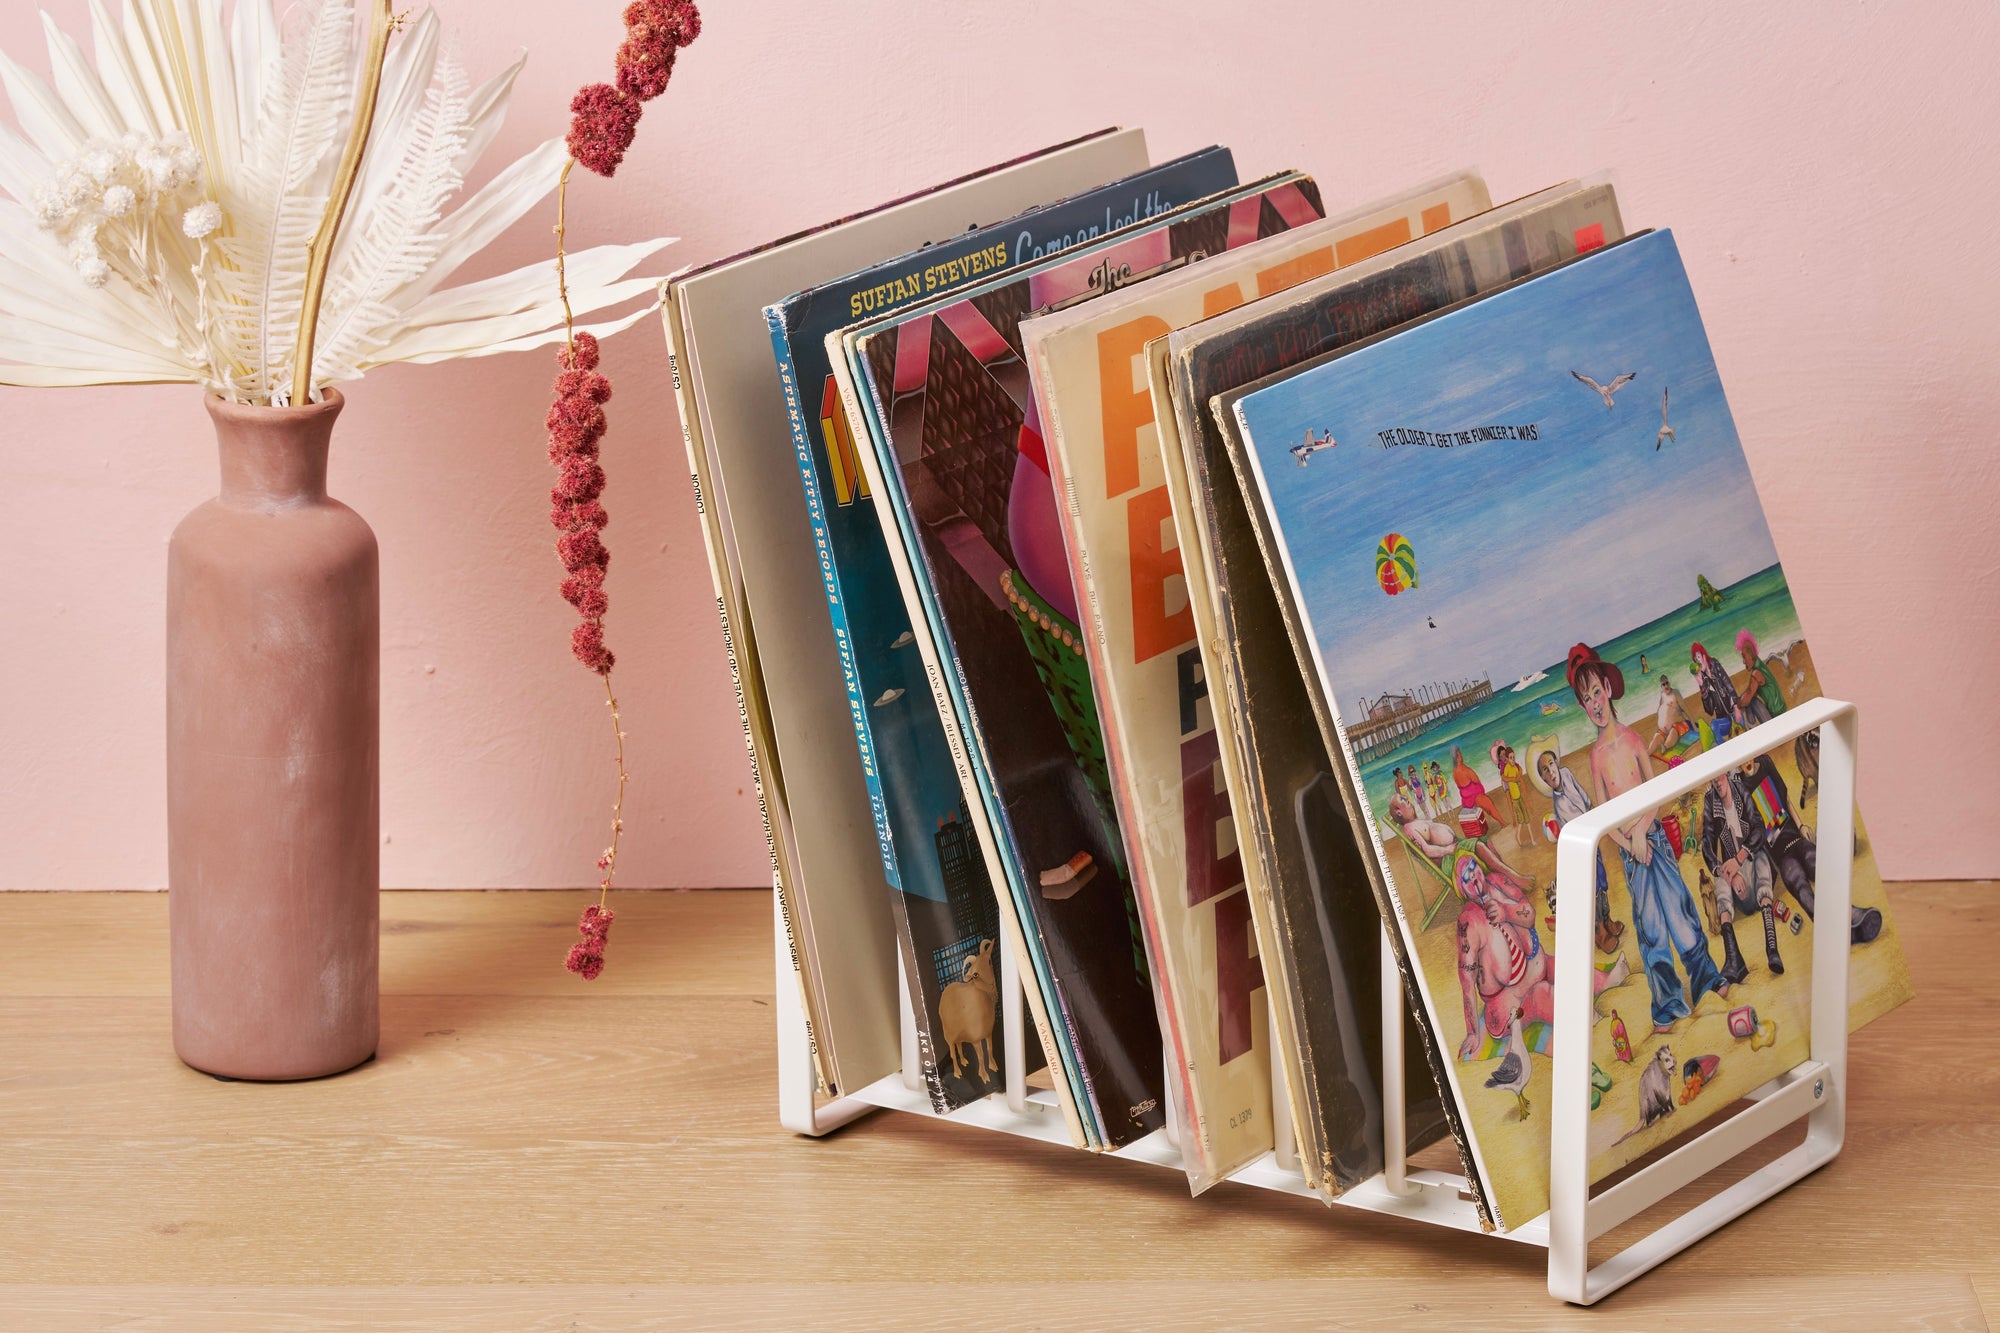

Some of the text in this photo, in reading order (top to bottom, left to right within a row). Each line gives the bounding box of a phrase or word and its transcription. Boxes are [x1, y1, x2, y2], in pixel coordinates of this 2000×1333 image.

[851, 241, 1007, 318] SUFJAN STEVENS
[1088, 256, 1132, 296] The
[1378, 424, 1538, 450] THE OLDER I GET THE FUNNIER I WAS
[691, 474, 705, 514] LONDON
[953, 657, 967, 684] DISCO
[779, 361, 808, 462] ASTHMATIC
[802, 469, 820, 520] KITTY
[815, 527, 838, 605] RECORDS
[836, 628, 857, 693] SUFJAN
[851, 699, 874, 777] STEVENS
[871, 795, 893, 871] ILLINOIS
[918, 1031, 929, 1054] AKR
[927, 664, 940, 689] JOAN
[937, 692, 948, 715] BAEZ
[946, 723, 962, 760] BLESSED
[1039, 1022, 1059, 1075] VANGUARD
[777, 880, 800, 972] RIMSKY-KORSAKO
